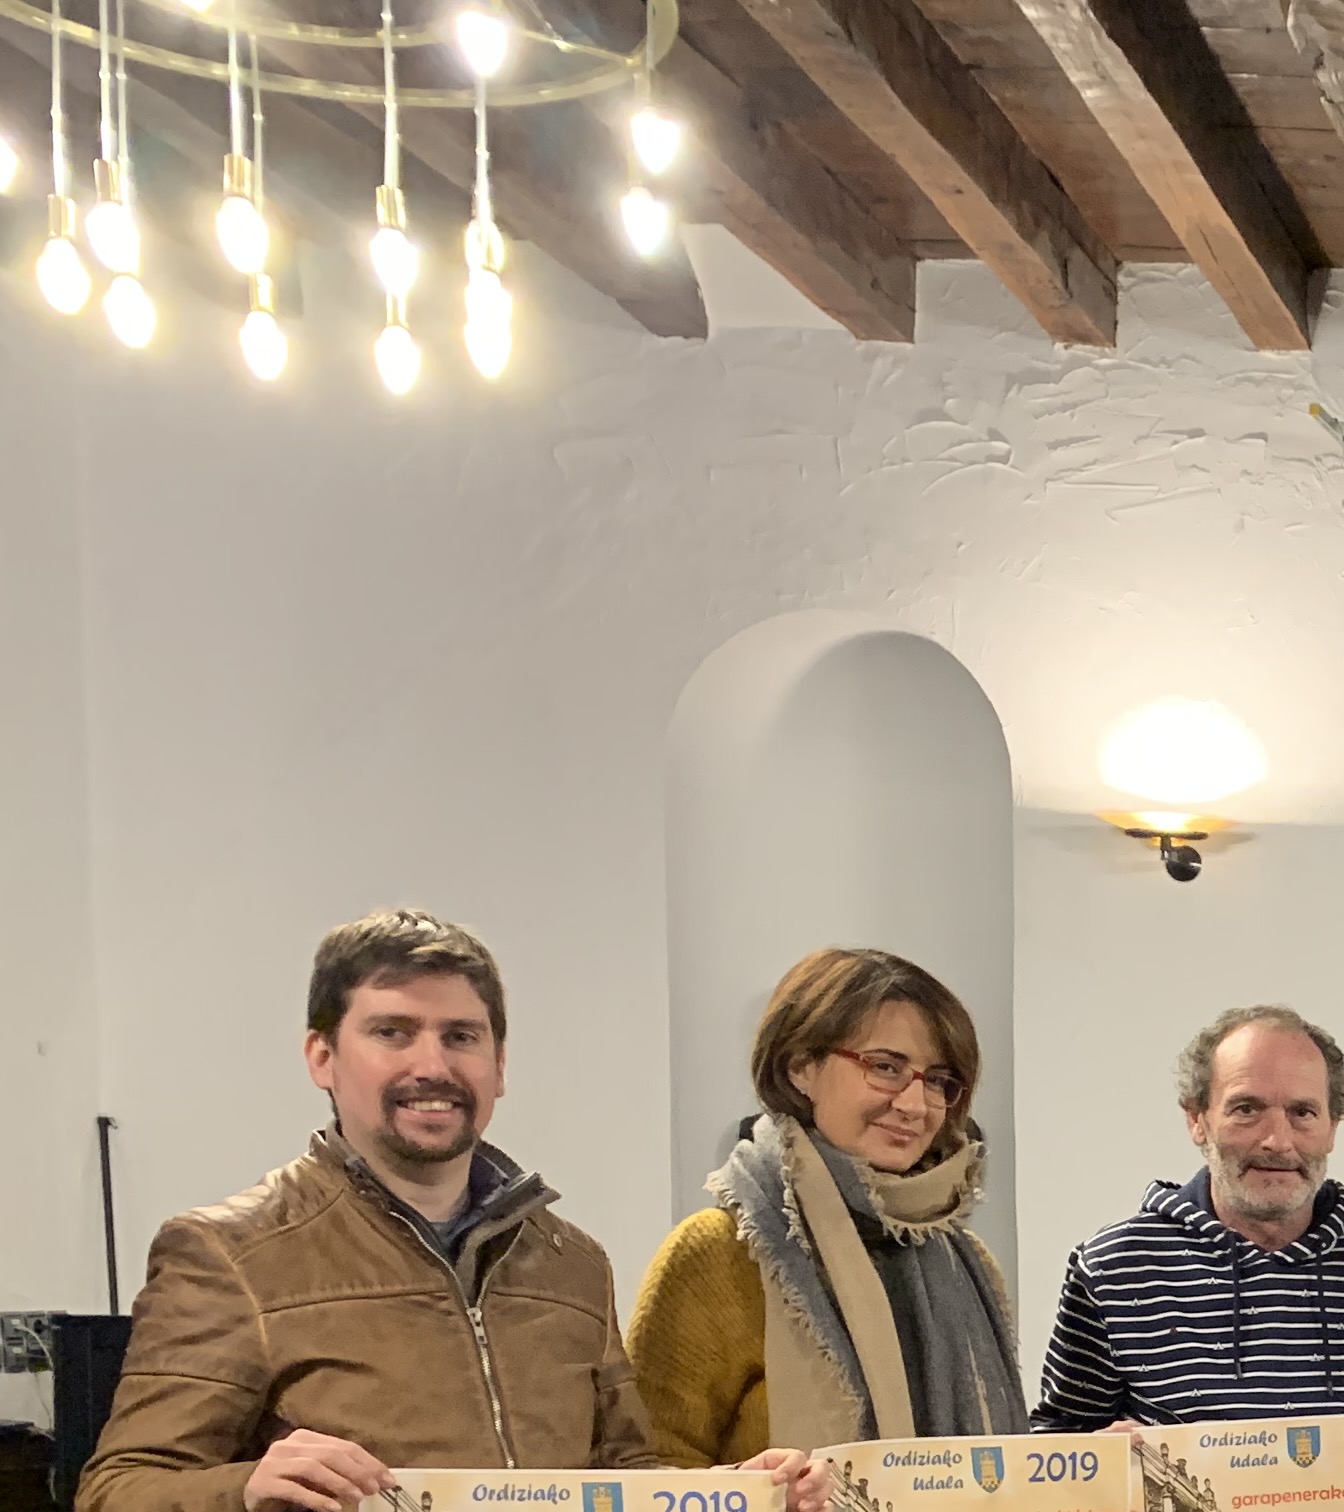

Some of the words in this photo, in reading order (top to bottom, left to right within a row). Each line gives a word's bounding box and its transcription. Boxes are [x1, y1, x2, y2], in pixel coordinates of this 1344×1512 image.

[1200, 1432, 1278, 1448] Ordiziako
[883, 1450, 962, 1468] Ordiziako
[1027, 1451, 1099, 1483] 2019
[1230, 1455, 1278, 1468] Udala
[913, 1476, 964, 1490] Udala
[472, 1483, 571, 1506] Ordiziako
